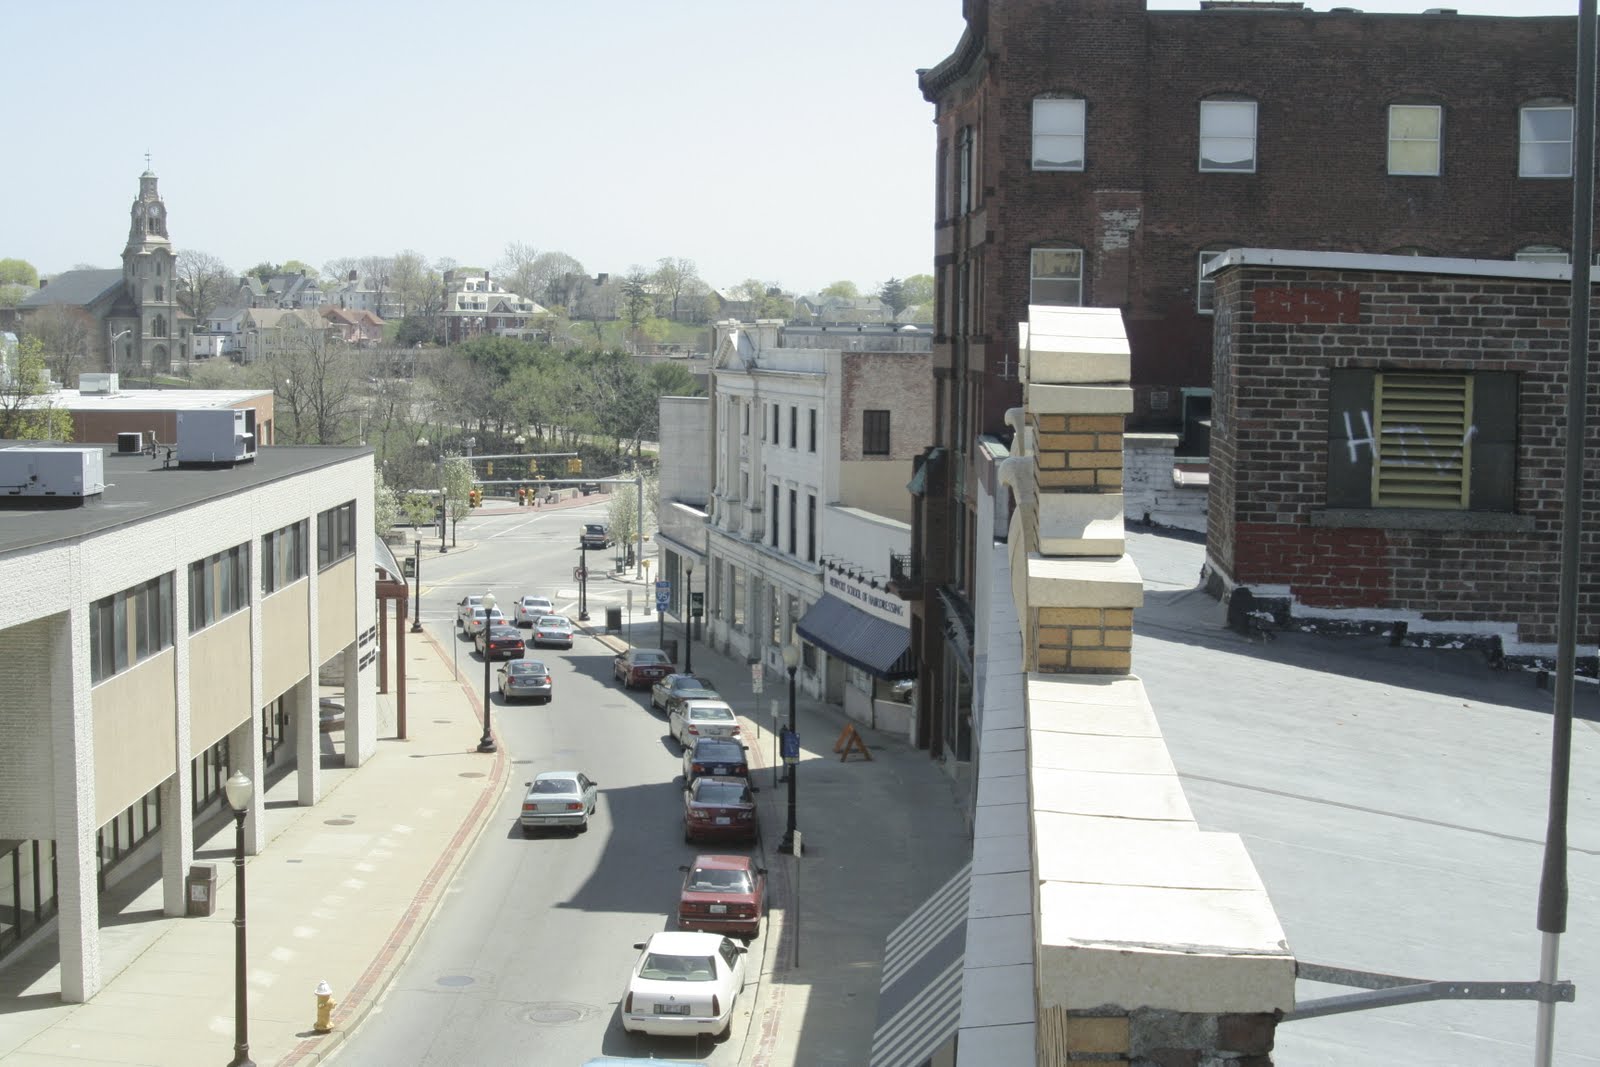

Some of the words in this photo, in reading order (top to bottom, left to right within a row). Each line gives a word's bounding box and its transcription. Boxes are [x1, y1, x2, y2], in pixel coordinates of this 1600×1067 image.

[657, 592, 668, 600] 95
[847, 585, 861, 600] SCHOOL
[862, 592, 867, 602] OF
[868, 595, 904, 616] HAIRDRESSING
